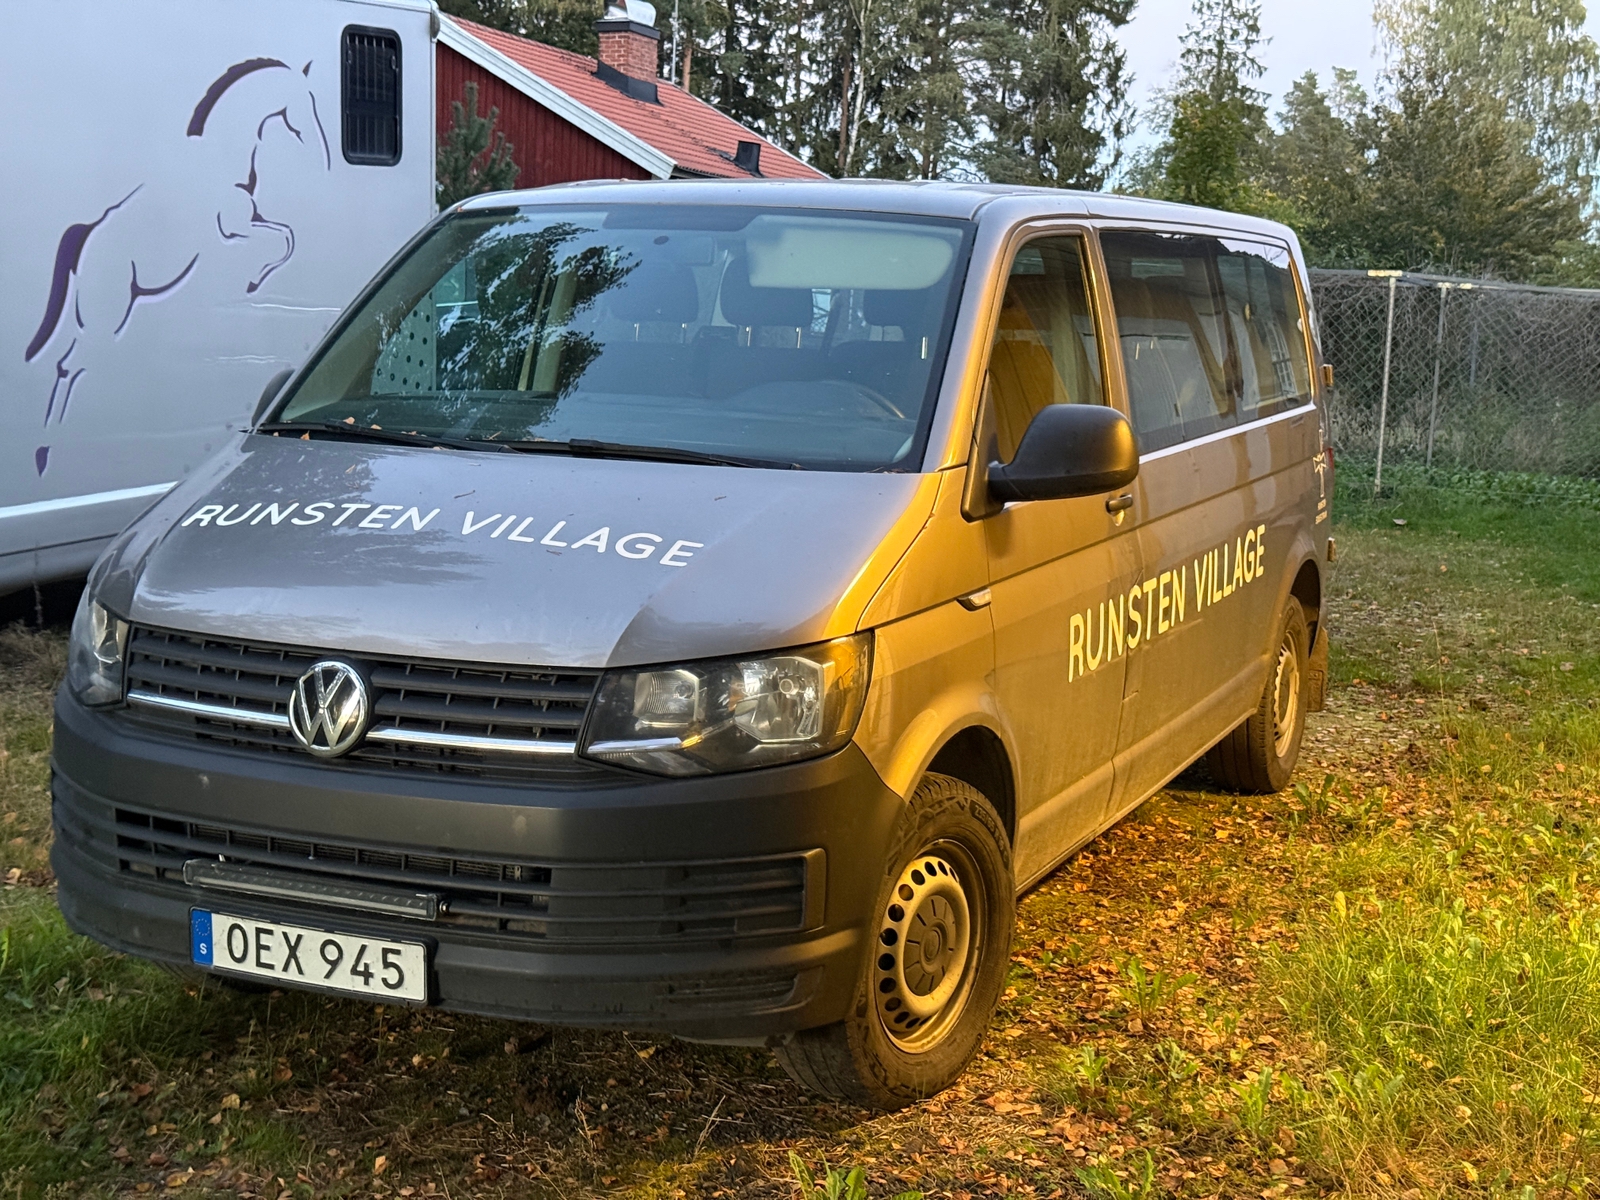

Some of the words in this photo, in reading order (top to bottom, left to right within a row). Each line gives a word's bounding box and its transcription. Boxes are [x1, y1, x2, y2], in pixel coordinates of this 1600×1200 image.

[181, 501, 442, 532] RUNSTEN
[461, 510, 705, 568] VILLAGE
[1068, 564, 1187, 684] RUNSTEN
[1194, 523, 1266, 613] VILLAGE
[291, 664, 364, 754] VW
[199, 942, 208, 956] S
[226, 922, 305, 976] OEX
[319, 937, 405, 990] 945
